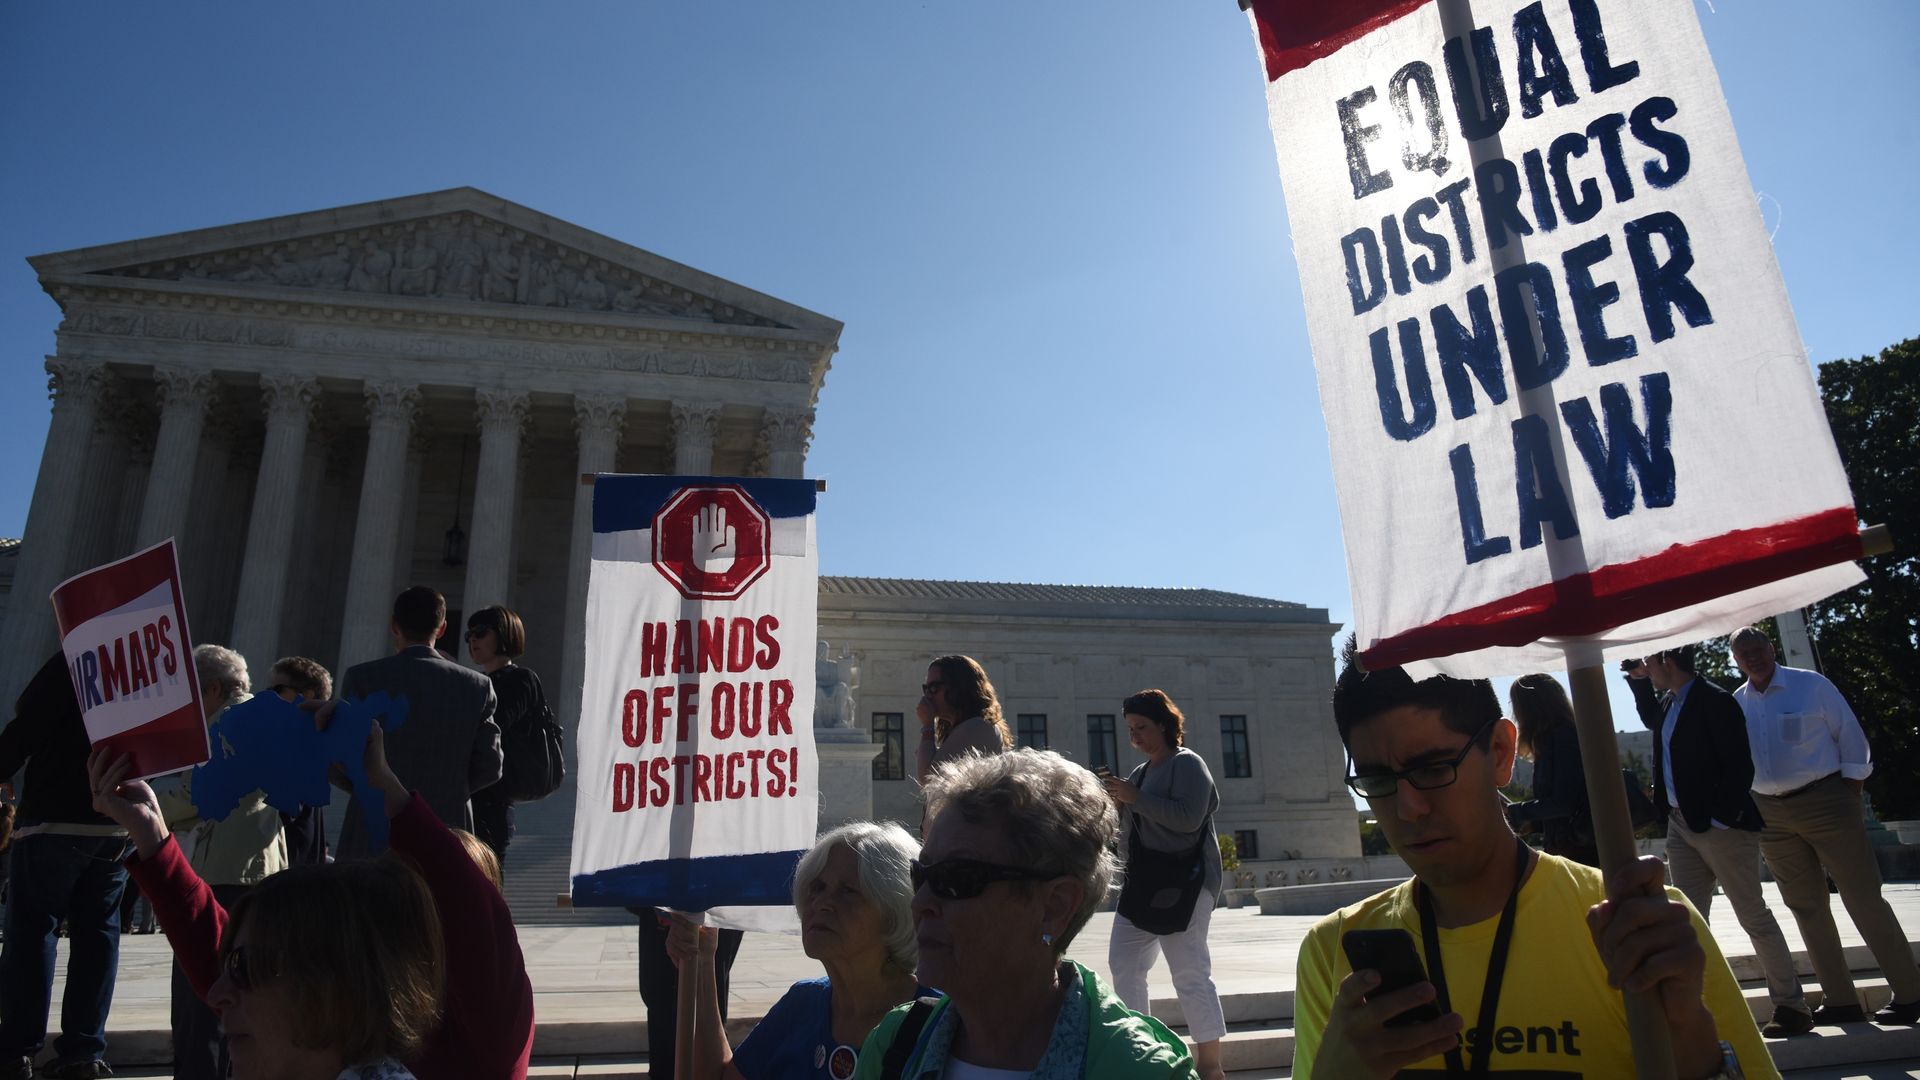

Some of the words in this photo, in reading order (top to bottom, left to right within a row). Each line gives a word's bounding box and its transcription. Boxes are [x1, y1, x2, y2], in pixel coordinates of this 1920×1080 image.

[1335, 0, 1640, 200] EQUAL
[1341, 96, 1691, 316] DISTRICTS
[1368, 211, 1715, 442] UNDER
[1449, 372, 1677, 565] LAW
[622, 683, 700, 748] OFF
[711, 679, 794, 740] OUR
[641, 614, 781, 678] HANDS
[612, 747, 798, 813] DISTRICTS!
